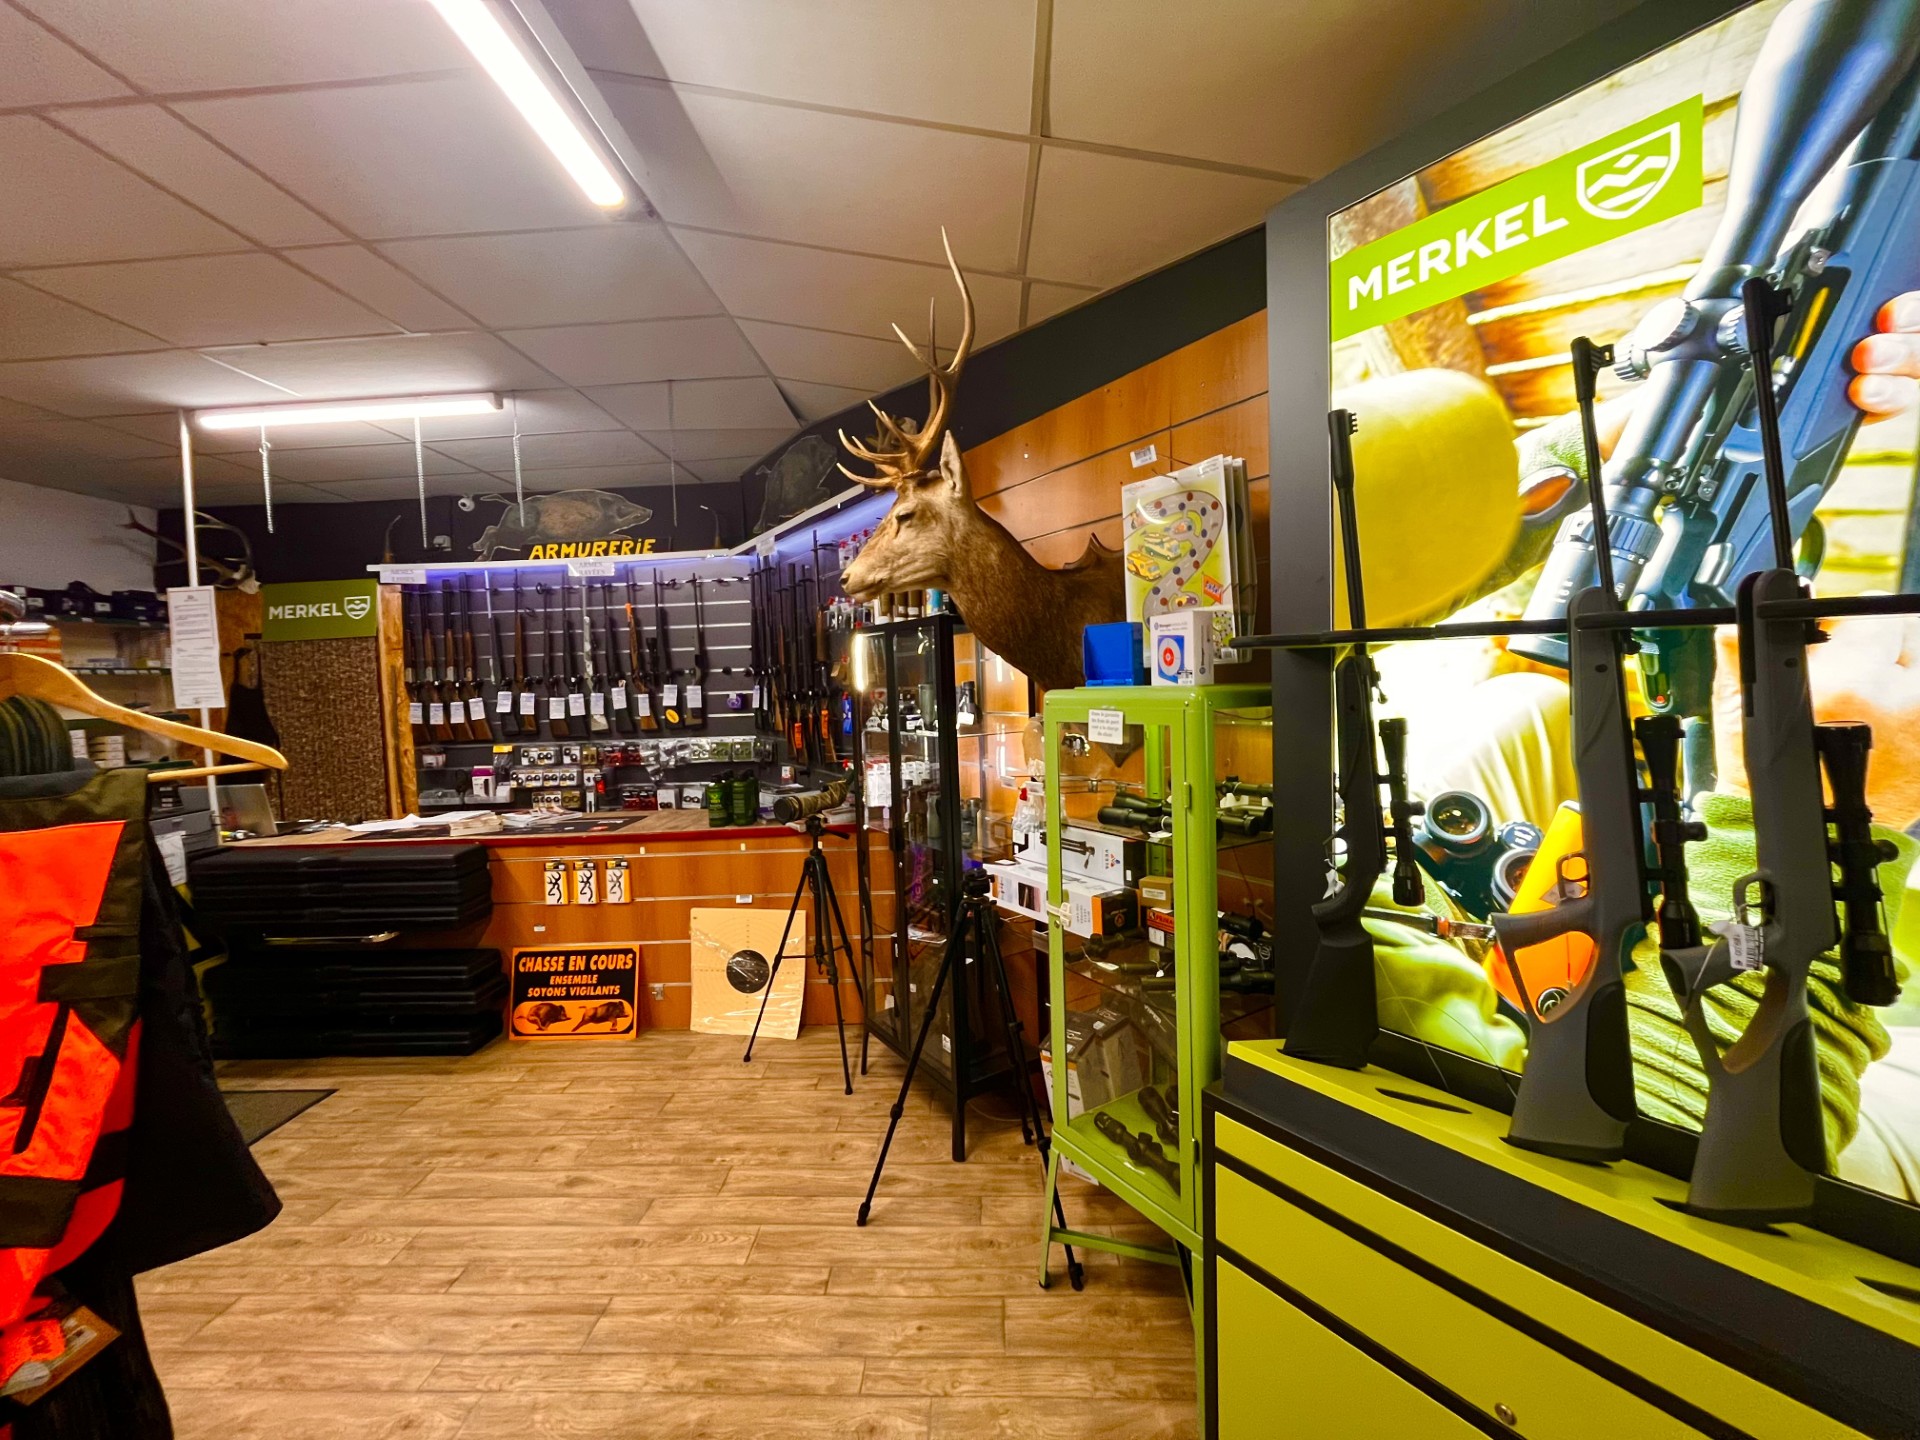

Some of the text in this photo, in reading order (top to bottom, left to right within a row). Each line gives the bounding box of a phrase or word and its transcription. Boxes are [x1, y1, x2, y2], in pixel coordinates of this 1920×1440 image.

[1348, 195, 1569, 311] MERKEL
[269, 603, 343, 620] MERKEL
[518, 954, 633, 972] CHASSE EN COURS
[549, 974, 598, 985] ENSEMBLE
[527, 985, 620, 997] SOYONS VIGILANTS
